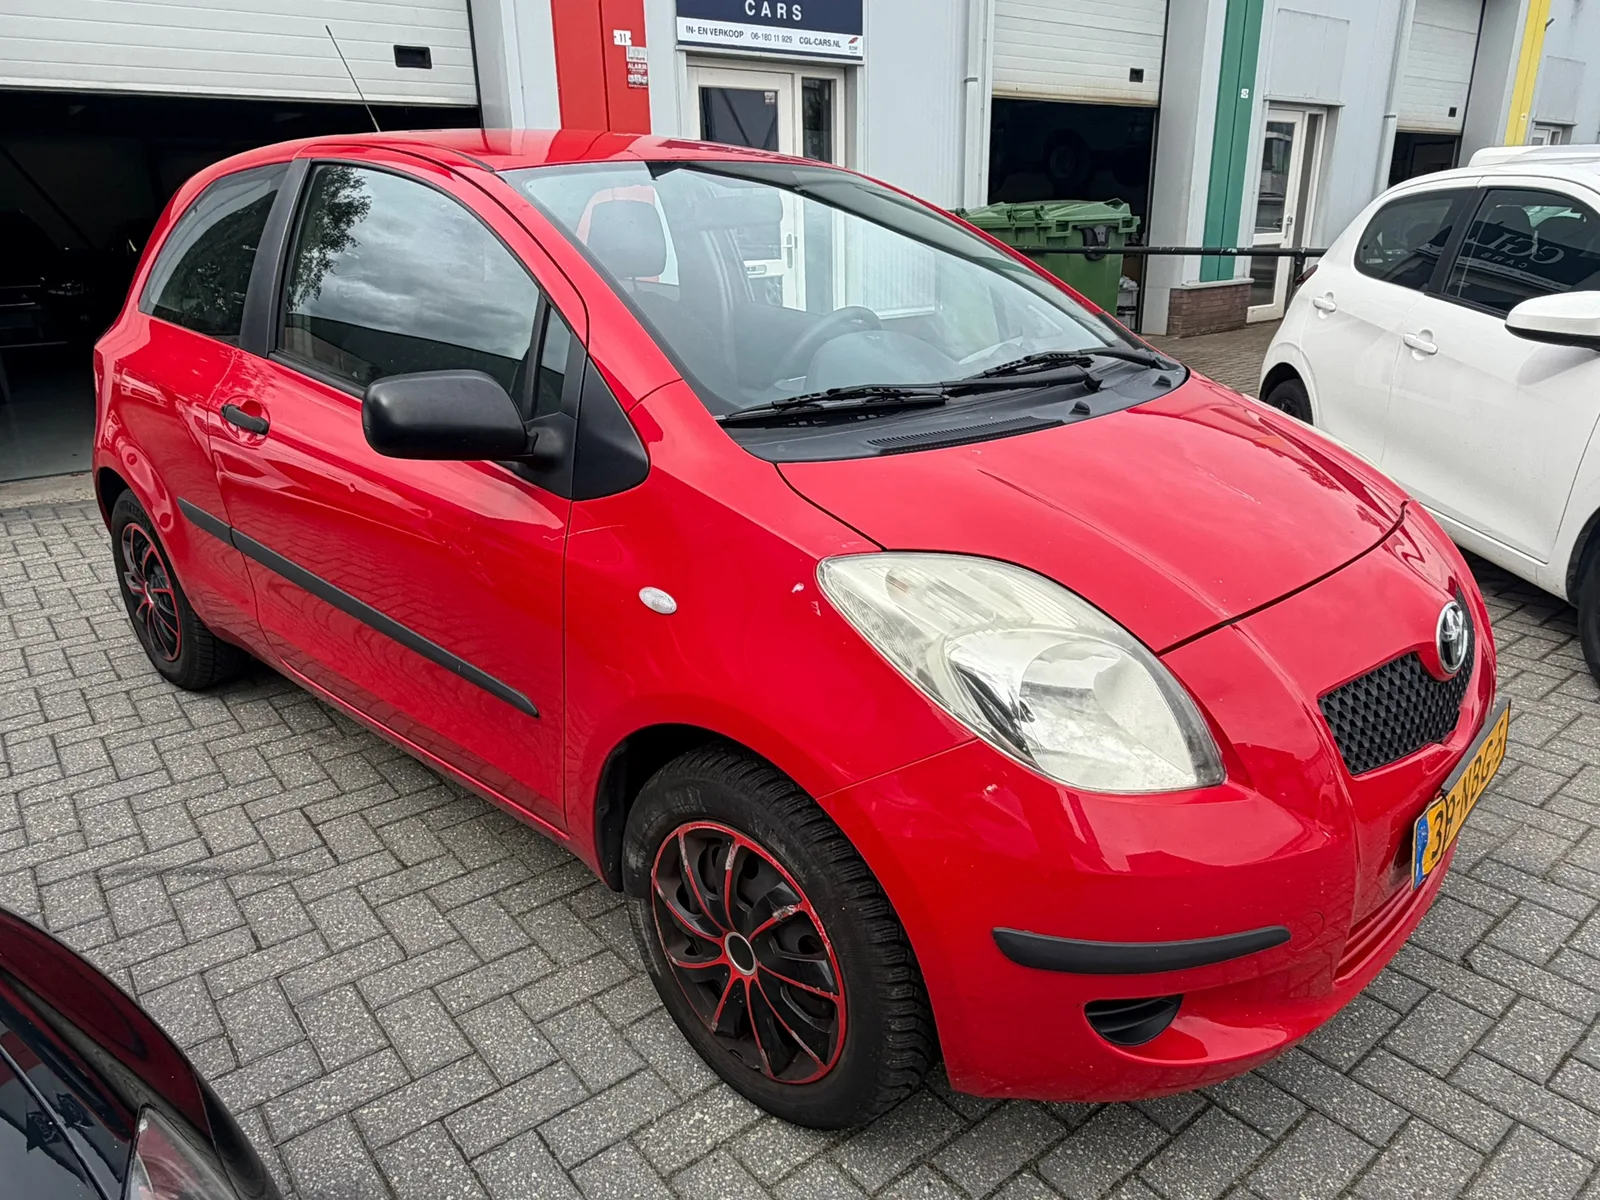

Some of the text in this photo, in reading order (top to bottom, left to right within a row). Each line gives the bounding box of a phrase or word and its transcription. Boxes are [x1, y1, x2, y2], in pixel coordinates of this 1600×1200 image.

[745, 1, 802, 21] CARS
[619, 33, 627, 43] 11
[686, 25, 696, 34] IN-
[698, 26, 708, 36] EN
[709, 28, 744, 39] VERKOOP
[774, 34, 780, 42] 11
[799, 36, 841, 48] CGL-CARS.NL
[627, 62, 647, 70] ALARM
